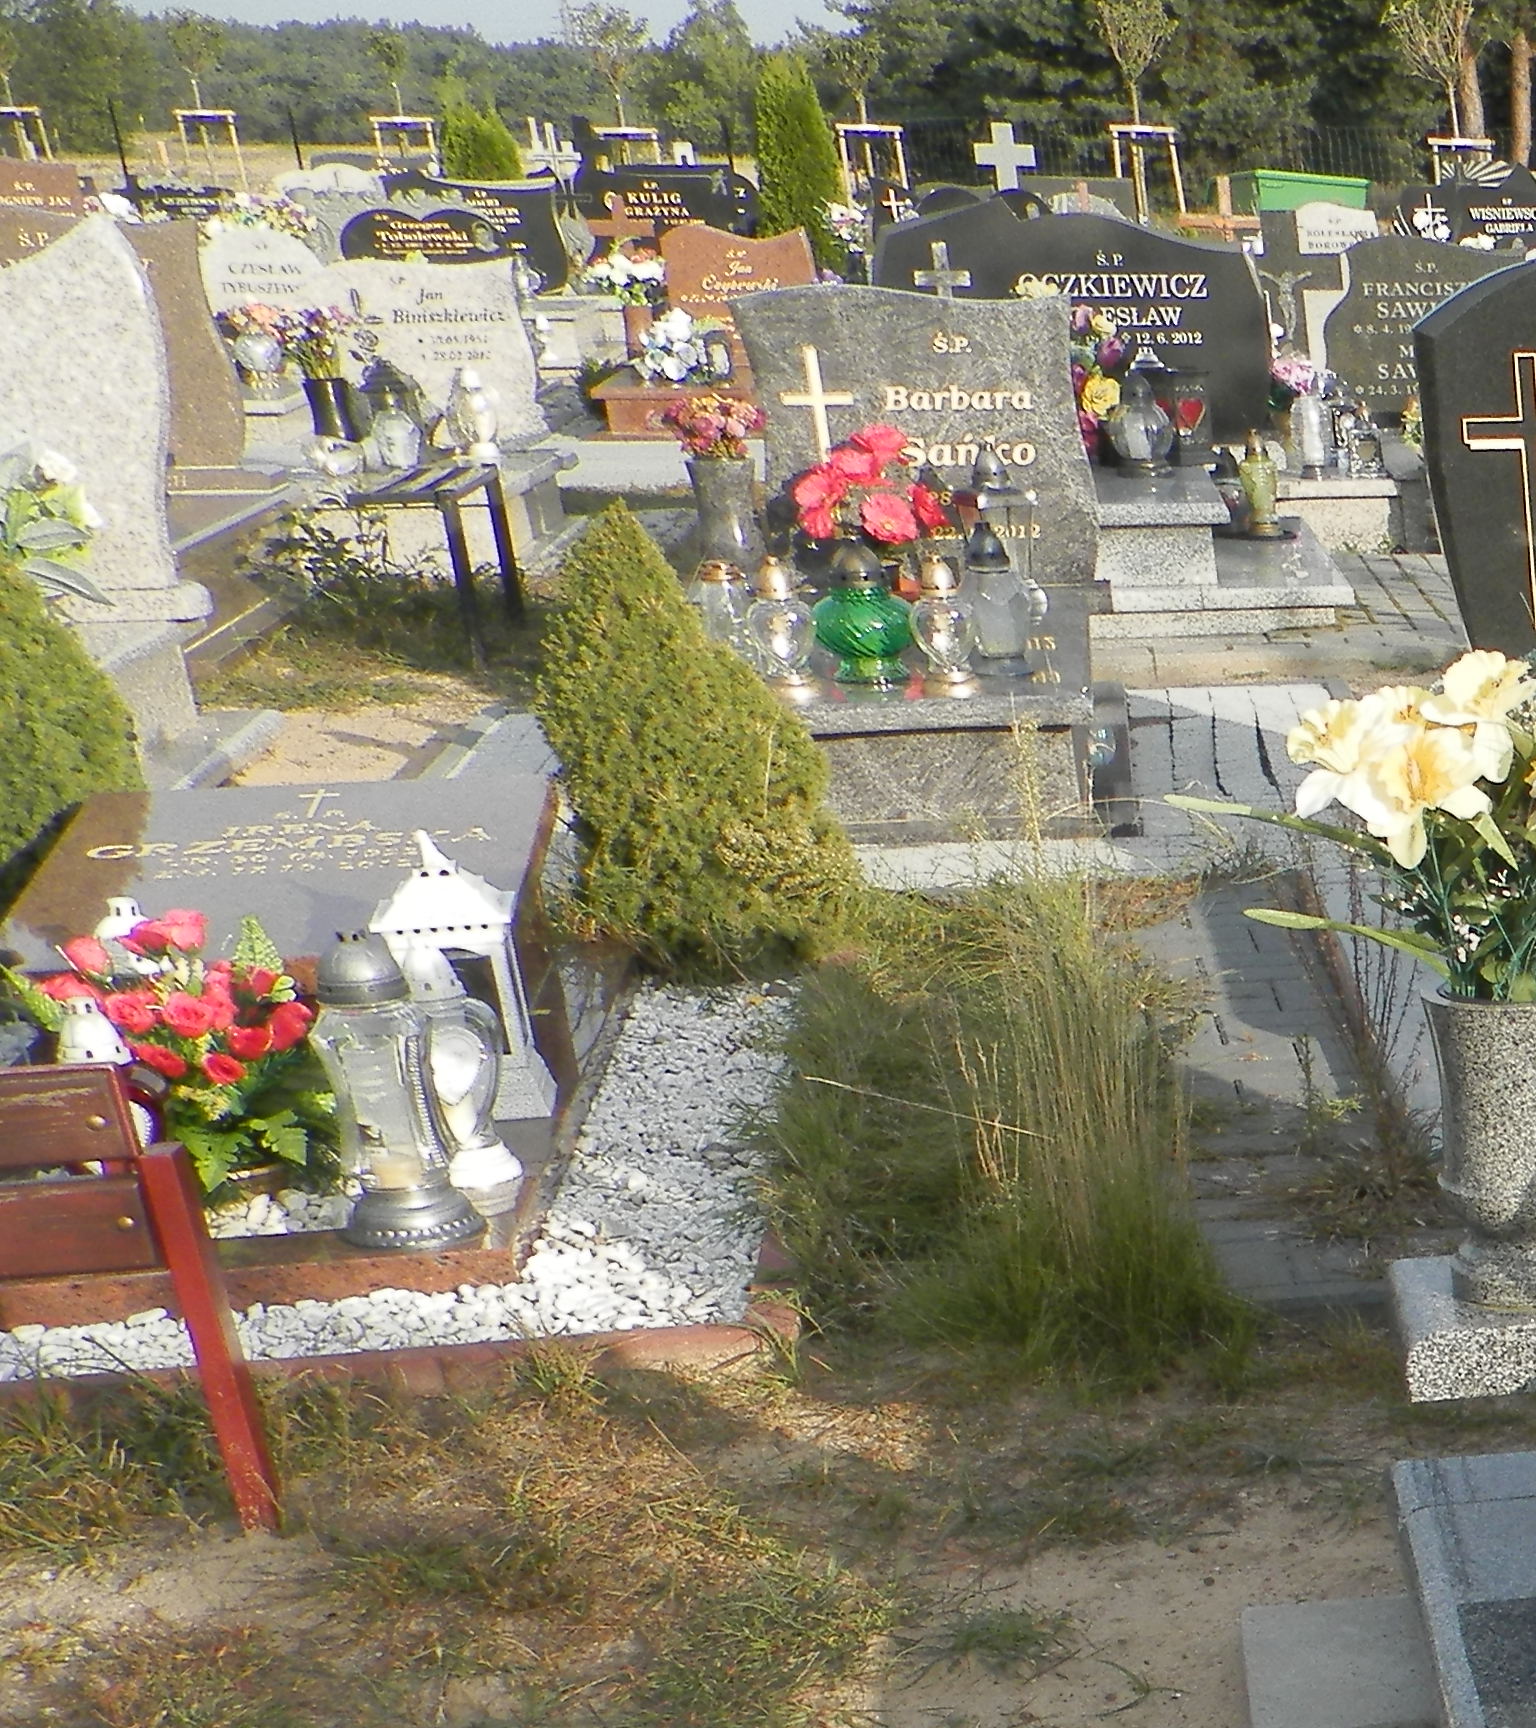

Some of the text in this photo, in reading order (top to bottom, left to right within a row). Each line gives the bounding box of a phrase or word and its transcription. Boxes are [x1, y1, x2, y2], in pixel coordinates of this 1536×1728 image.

[626, 191, 682, 204] KULIG
[624, 205, 690, 217] GRAŻYNA
[415, 288, 443, 306] Jan
[1172, 332, 1204, 345] 2012
[884, 384, 1035, 412] Barbara
[222, 820, 381, 839] IRENA
